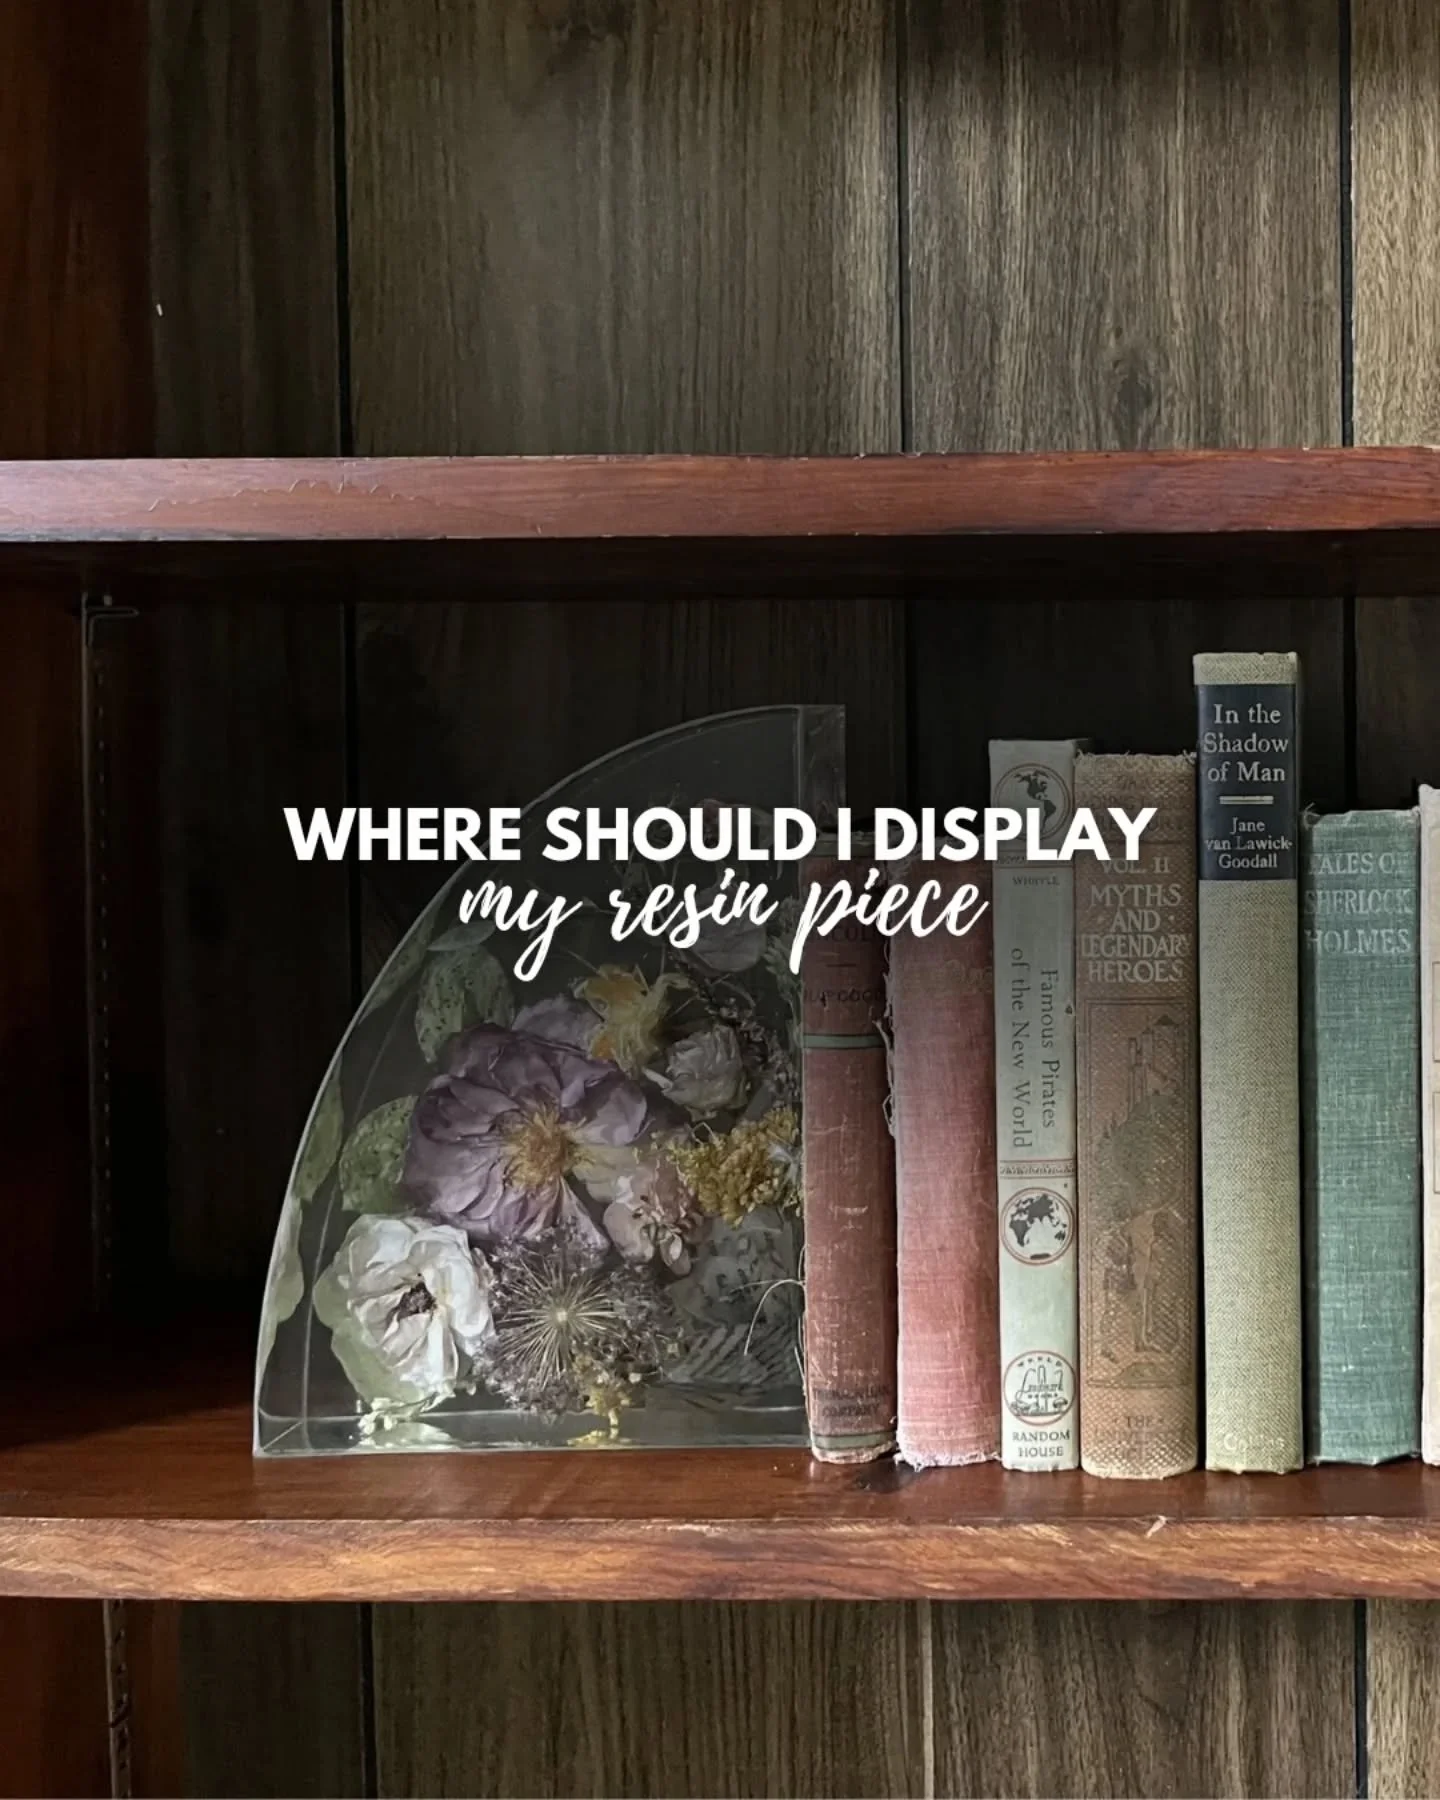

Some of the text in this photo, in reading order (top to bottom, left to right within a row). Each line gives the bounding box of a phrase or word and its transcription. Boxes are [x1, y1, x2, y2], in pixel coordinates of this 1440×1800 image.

[1213, 703, 1282, 725] In the
[1203, 731, 1290, 754] Shadow
[1207, 761, 1286, 782] of Man
[1230, 817, 1266, 835] Jane
[1204, 835, 1293, 851] van Lawick-
[1218, 853, 1278, 869] Goodall
[1090, 883, 1182, 908] MYTHS
[1304, 888, 1414, 915] SHERLOCK
[1109, 910, 1162, 933] AND
[1304, 928, 1412, 956] HOLMES
[1087, 960, 1185, 984] HEROES
[1011, 948, 1033, 1149] of the New World
[1040, 969, 1061, 1130] Famous Pirates
[1012, 1430, 1071, 1441] RANDOM
[1018, 1446, 1065, 1457] HOUSE
